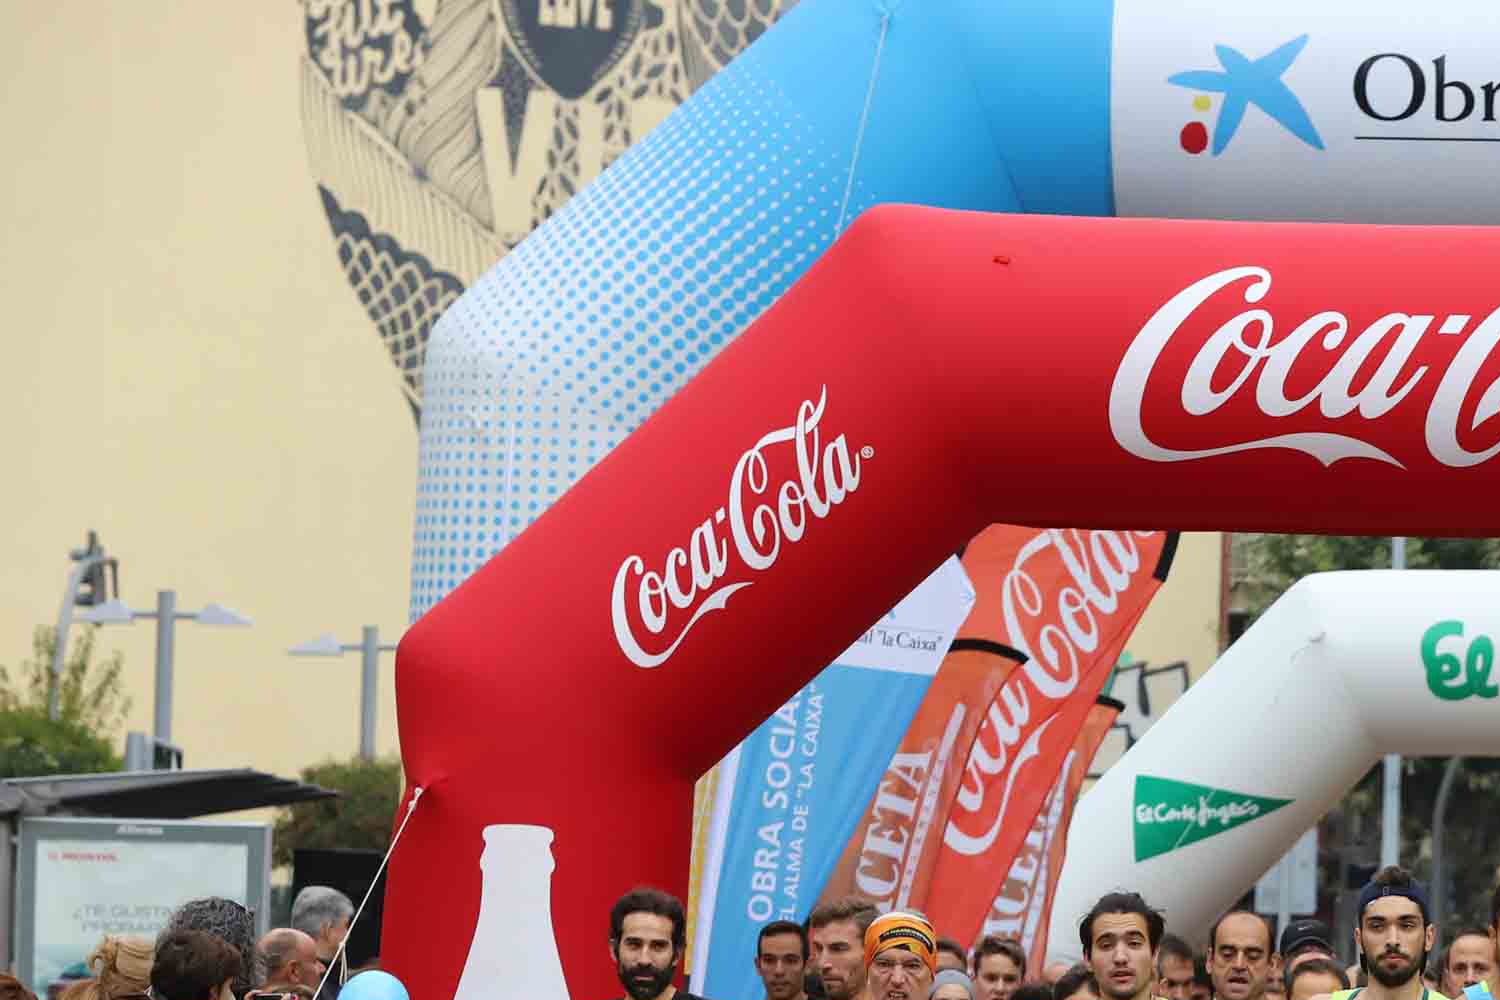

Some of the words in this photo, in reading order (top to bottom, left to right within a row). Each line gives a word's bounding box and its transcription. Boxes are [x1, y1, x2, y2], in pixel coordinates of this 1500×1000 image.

[1421, 620, 1498, 700] El
[762, 690, 802, 809] SOCIA
[792, 804, 809, 832] DE
[1135, 803, 1154, 823] El
[1154, 801, 1196, 823] Corte
[747, 820, 785, 922] OBRA
[784, 838, 804, 903] ALMA
